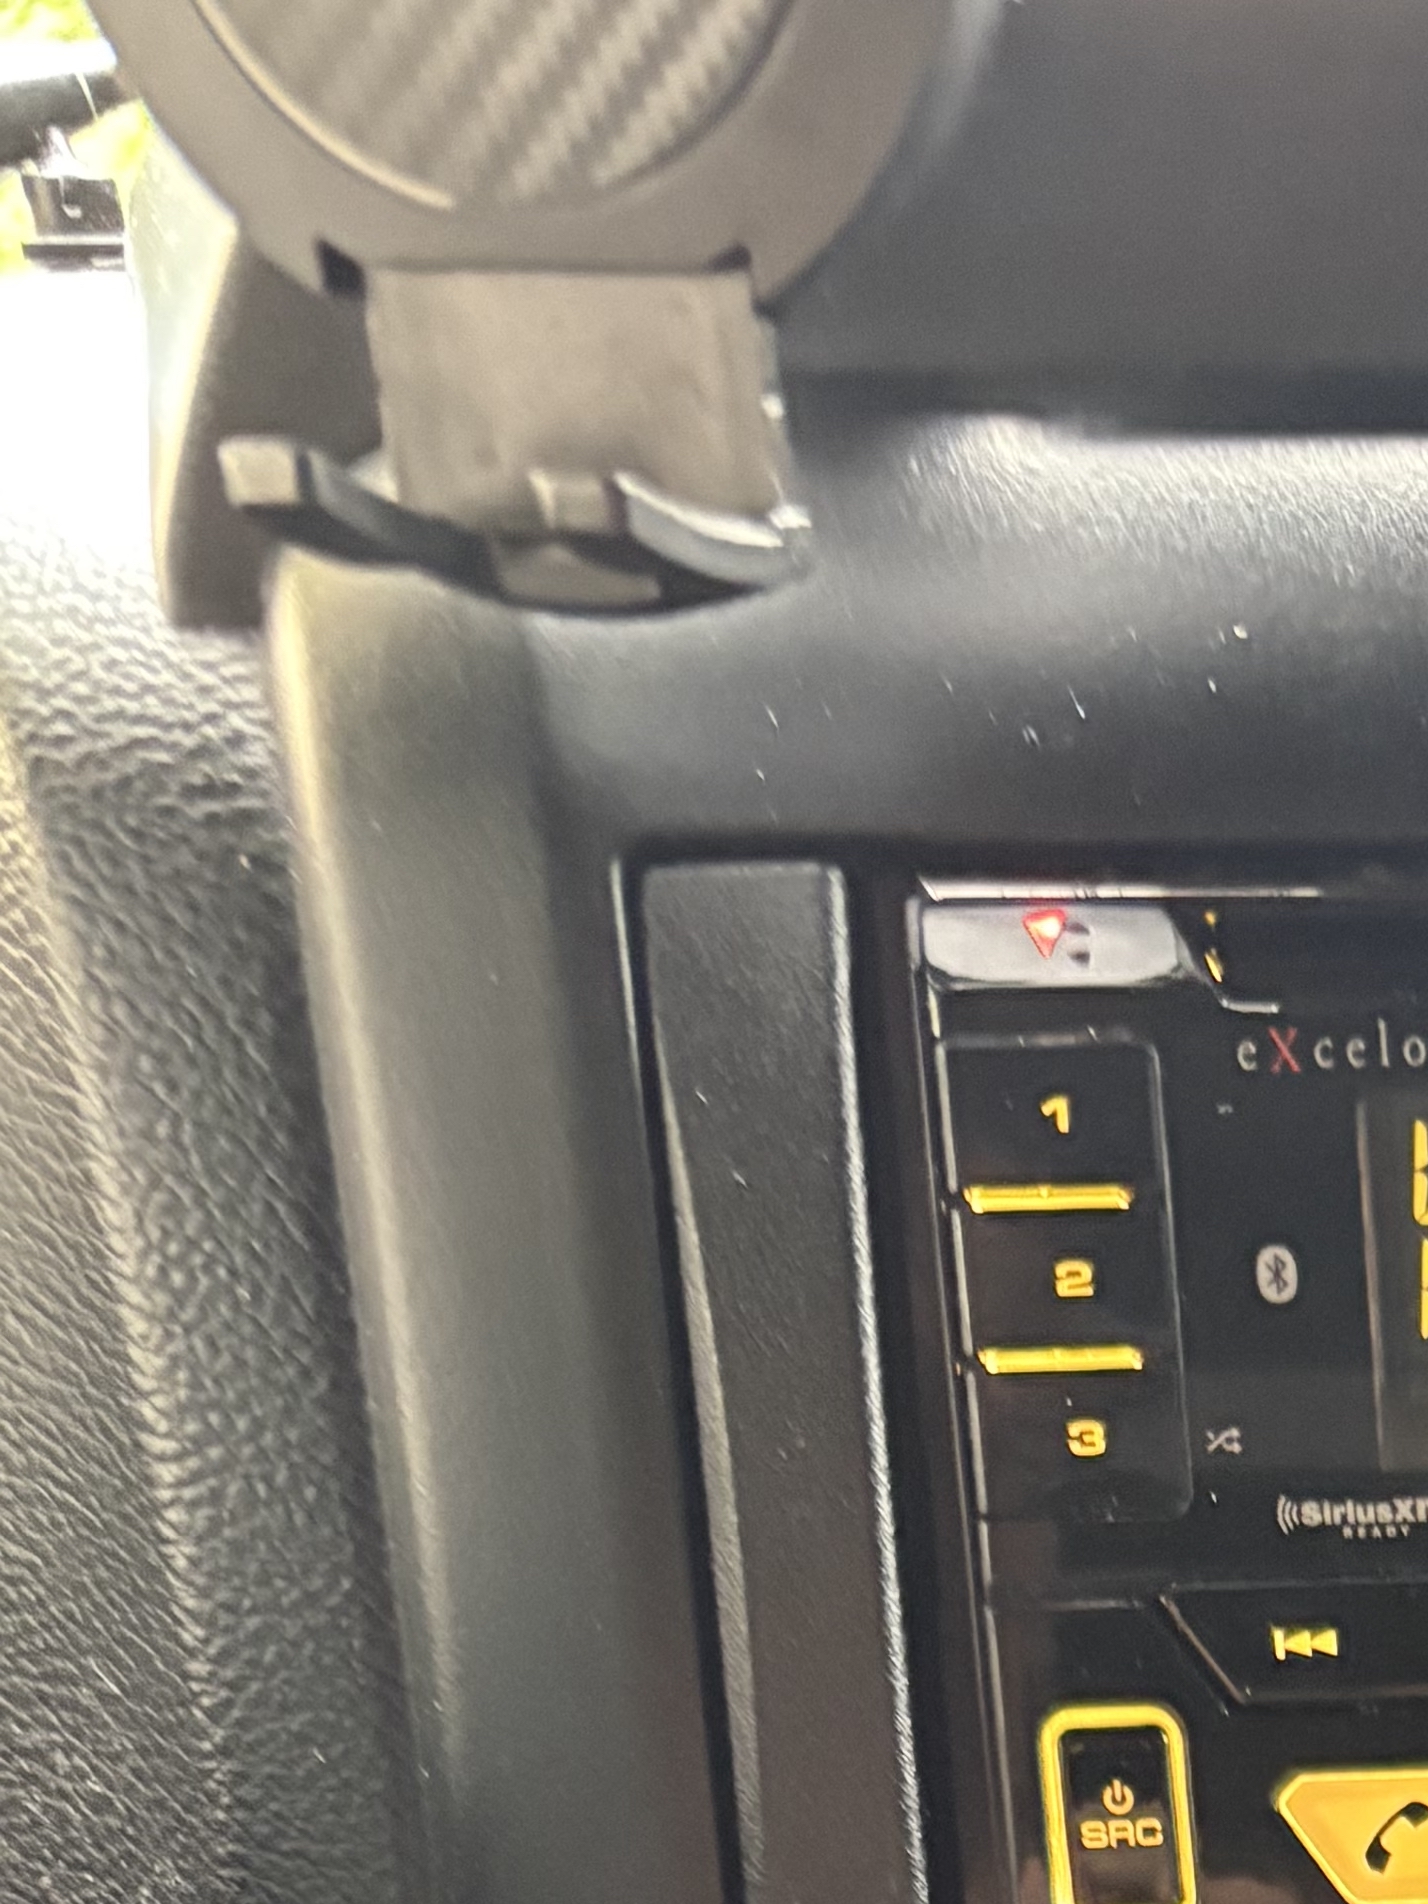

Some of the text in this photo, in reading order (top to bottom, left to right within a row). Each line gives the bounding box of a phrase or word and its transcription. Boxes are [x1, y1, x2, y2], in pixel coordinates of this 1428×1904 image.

[1041, 1096, 1070, 1133] 1
[1055, 1261, 1094, 1297] 2
[1067, 1421, 1106, 1457] 3
[1080, 1817, 1163, 1849] SRC
